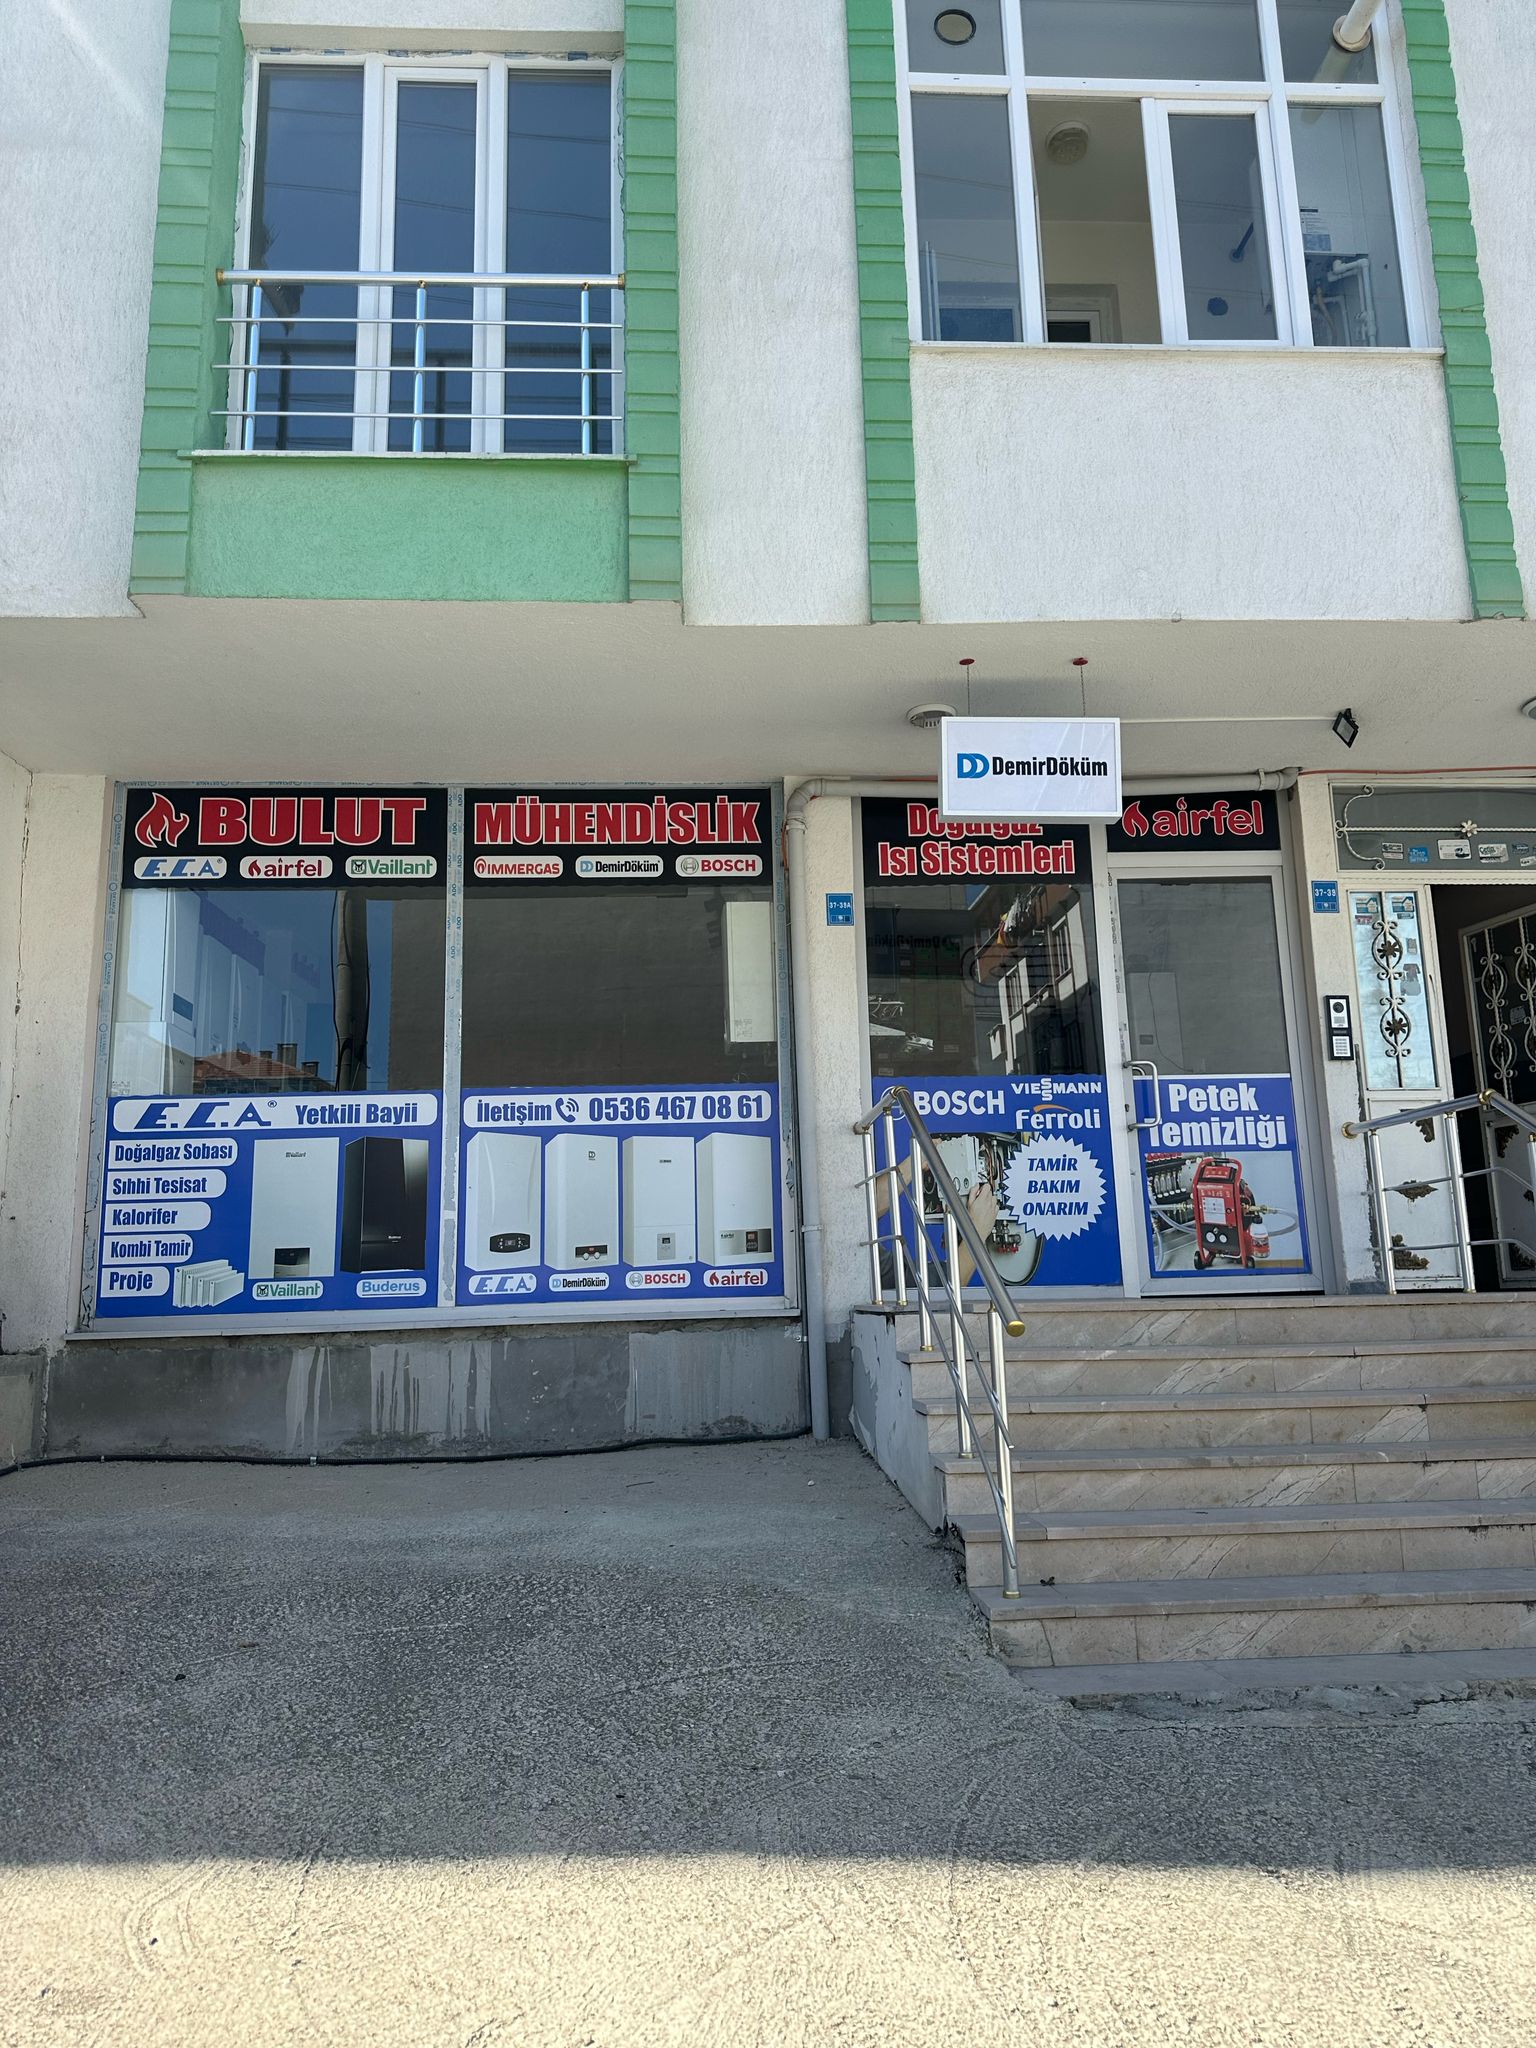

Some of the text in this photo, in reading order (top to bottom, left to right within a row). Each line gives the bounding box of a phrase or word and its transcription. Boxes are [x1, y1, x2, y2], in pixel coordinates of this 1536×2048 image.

[992, 756, 1108, 777] DemirDöküm
[198, 797, 427, 846] BULUT
[474, 795, 762, 845] MÜHENDİSLİK
[1153, 796, 1264, 837] airfel
[264, 857, 322, 877] airfel
[369, 859, 433, 875] Vaillant
[595, 860, 659, 873] DemirDöküm
[701, 859, 756, 872] BOSCH
[878, 840, 1076, 876] Isı Sistemleri
[488, 862, 560, 875] IMMERGAS
[1011, 1077, 1102, 1101] VIESSMANN
[1168, 1083, 1259, 1112] Petek
[477, 1094, 763, 1125] İletişim 0536 467 08 61
[914, 1090, 1006, 1116] BOSCH
[296, 1103, 361, 1125] Yetkili
[366, 1103, 418, 1125] Bayii
[1015, 1108, 1101, 1130] Ferroli
[1144, 1114, 1287, 1148] Temizliği
[114, 1141, 233, 1163] Doğalgaz Sobası
[1028, 1154, 1079, 1172] TAMİR
[112, 1177, 207, 1195] Sıhhi Tesisat
[1028, 1180, 1080, 1194] BAKIM
[112, 1208, 178, 1226] Kalorifer
[1023, 1201, 1089, 1216] ONARIM
[111, 1239, 191, 1258] Kombi Tamir
[109, 1271, 153, 1291] Proje
[362, 1280, 420, 1293] Buderus
[563, 1276, 606, 1289] DemirDöküm
[644, 1273, 686, 1285] BOSCH
[721, 1269, 764, 1286] airfel
[269, 1282, 321, 1297] Vaillant
